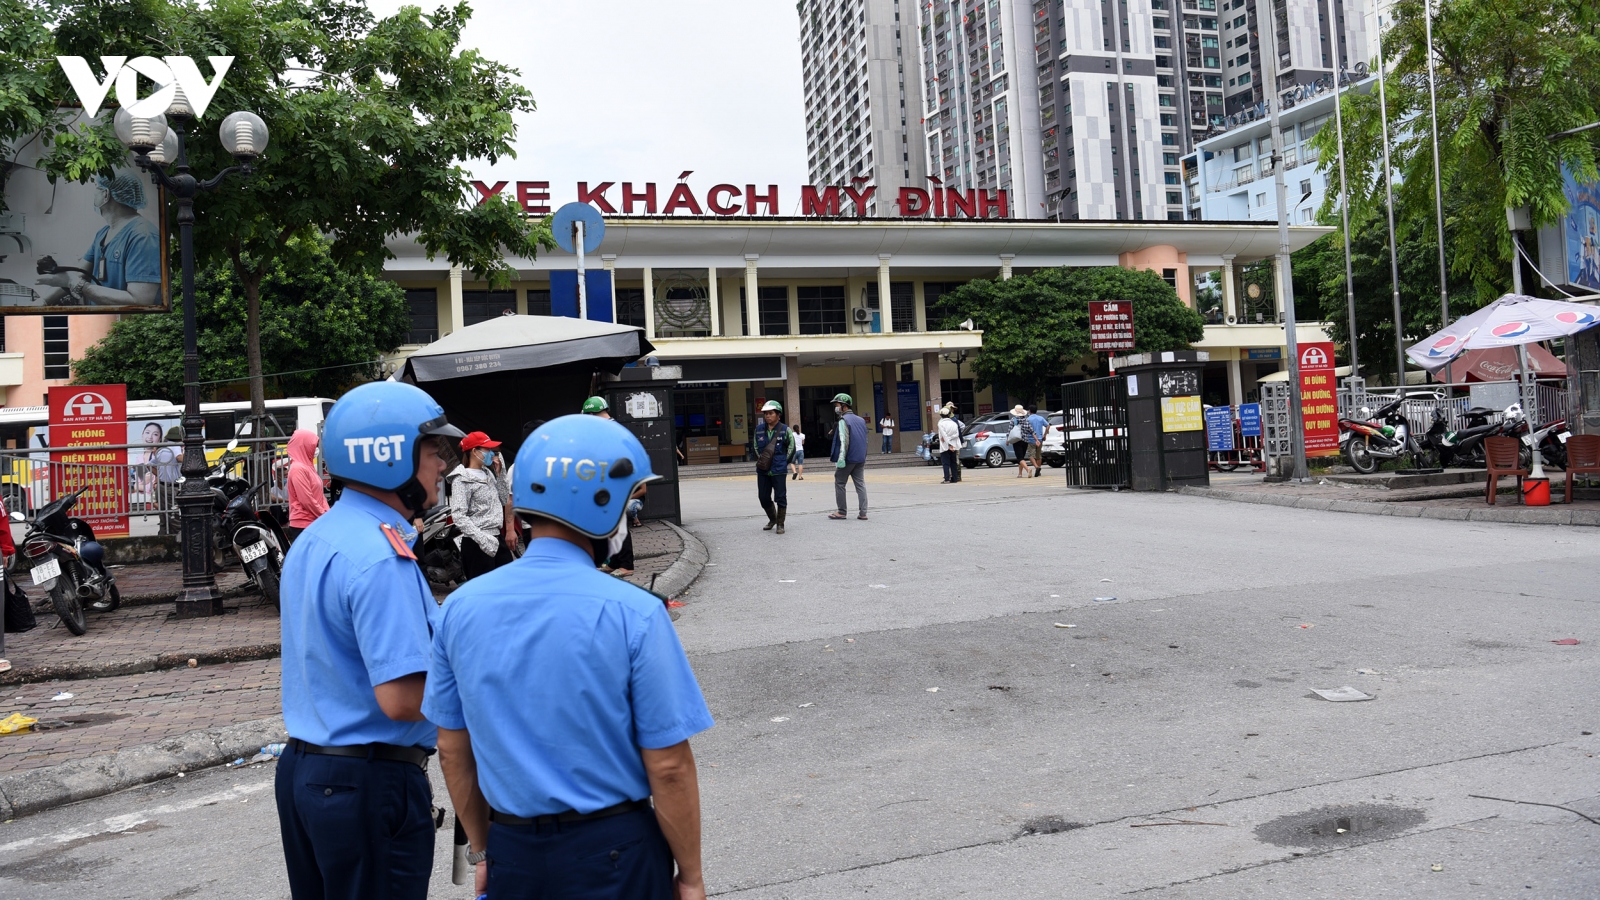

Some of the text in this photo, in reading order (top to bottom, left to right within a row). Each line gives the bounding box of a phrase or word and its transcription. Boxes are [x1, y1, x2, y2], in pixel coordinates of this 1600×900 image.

[1354, 61, 1367, 78] 9
[469, 170, 1009, 218] XE KHÁCH MỸ ĐÌNH
[1103, 302, 1118, 312] CẤM
[1304, 374, 1326, 385] ĐI ĐÚNG
[1301, 390, 1311, 400] LÀN
[1316, 403, 1334, 414] ĐƯỜNG
[1305, 420, 1330, 430] QUY ĐỊNH
[71, 429, 105, 438] KHÔNG
[344, 434, 405, 464] TTGT
[62, 453, 116, 463] ĐIỆN THOẠI
[545, 457, 608, 482] TTGT
